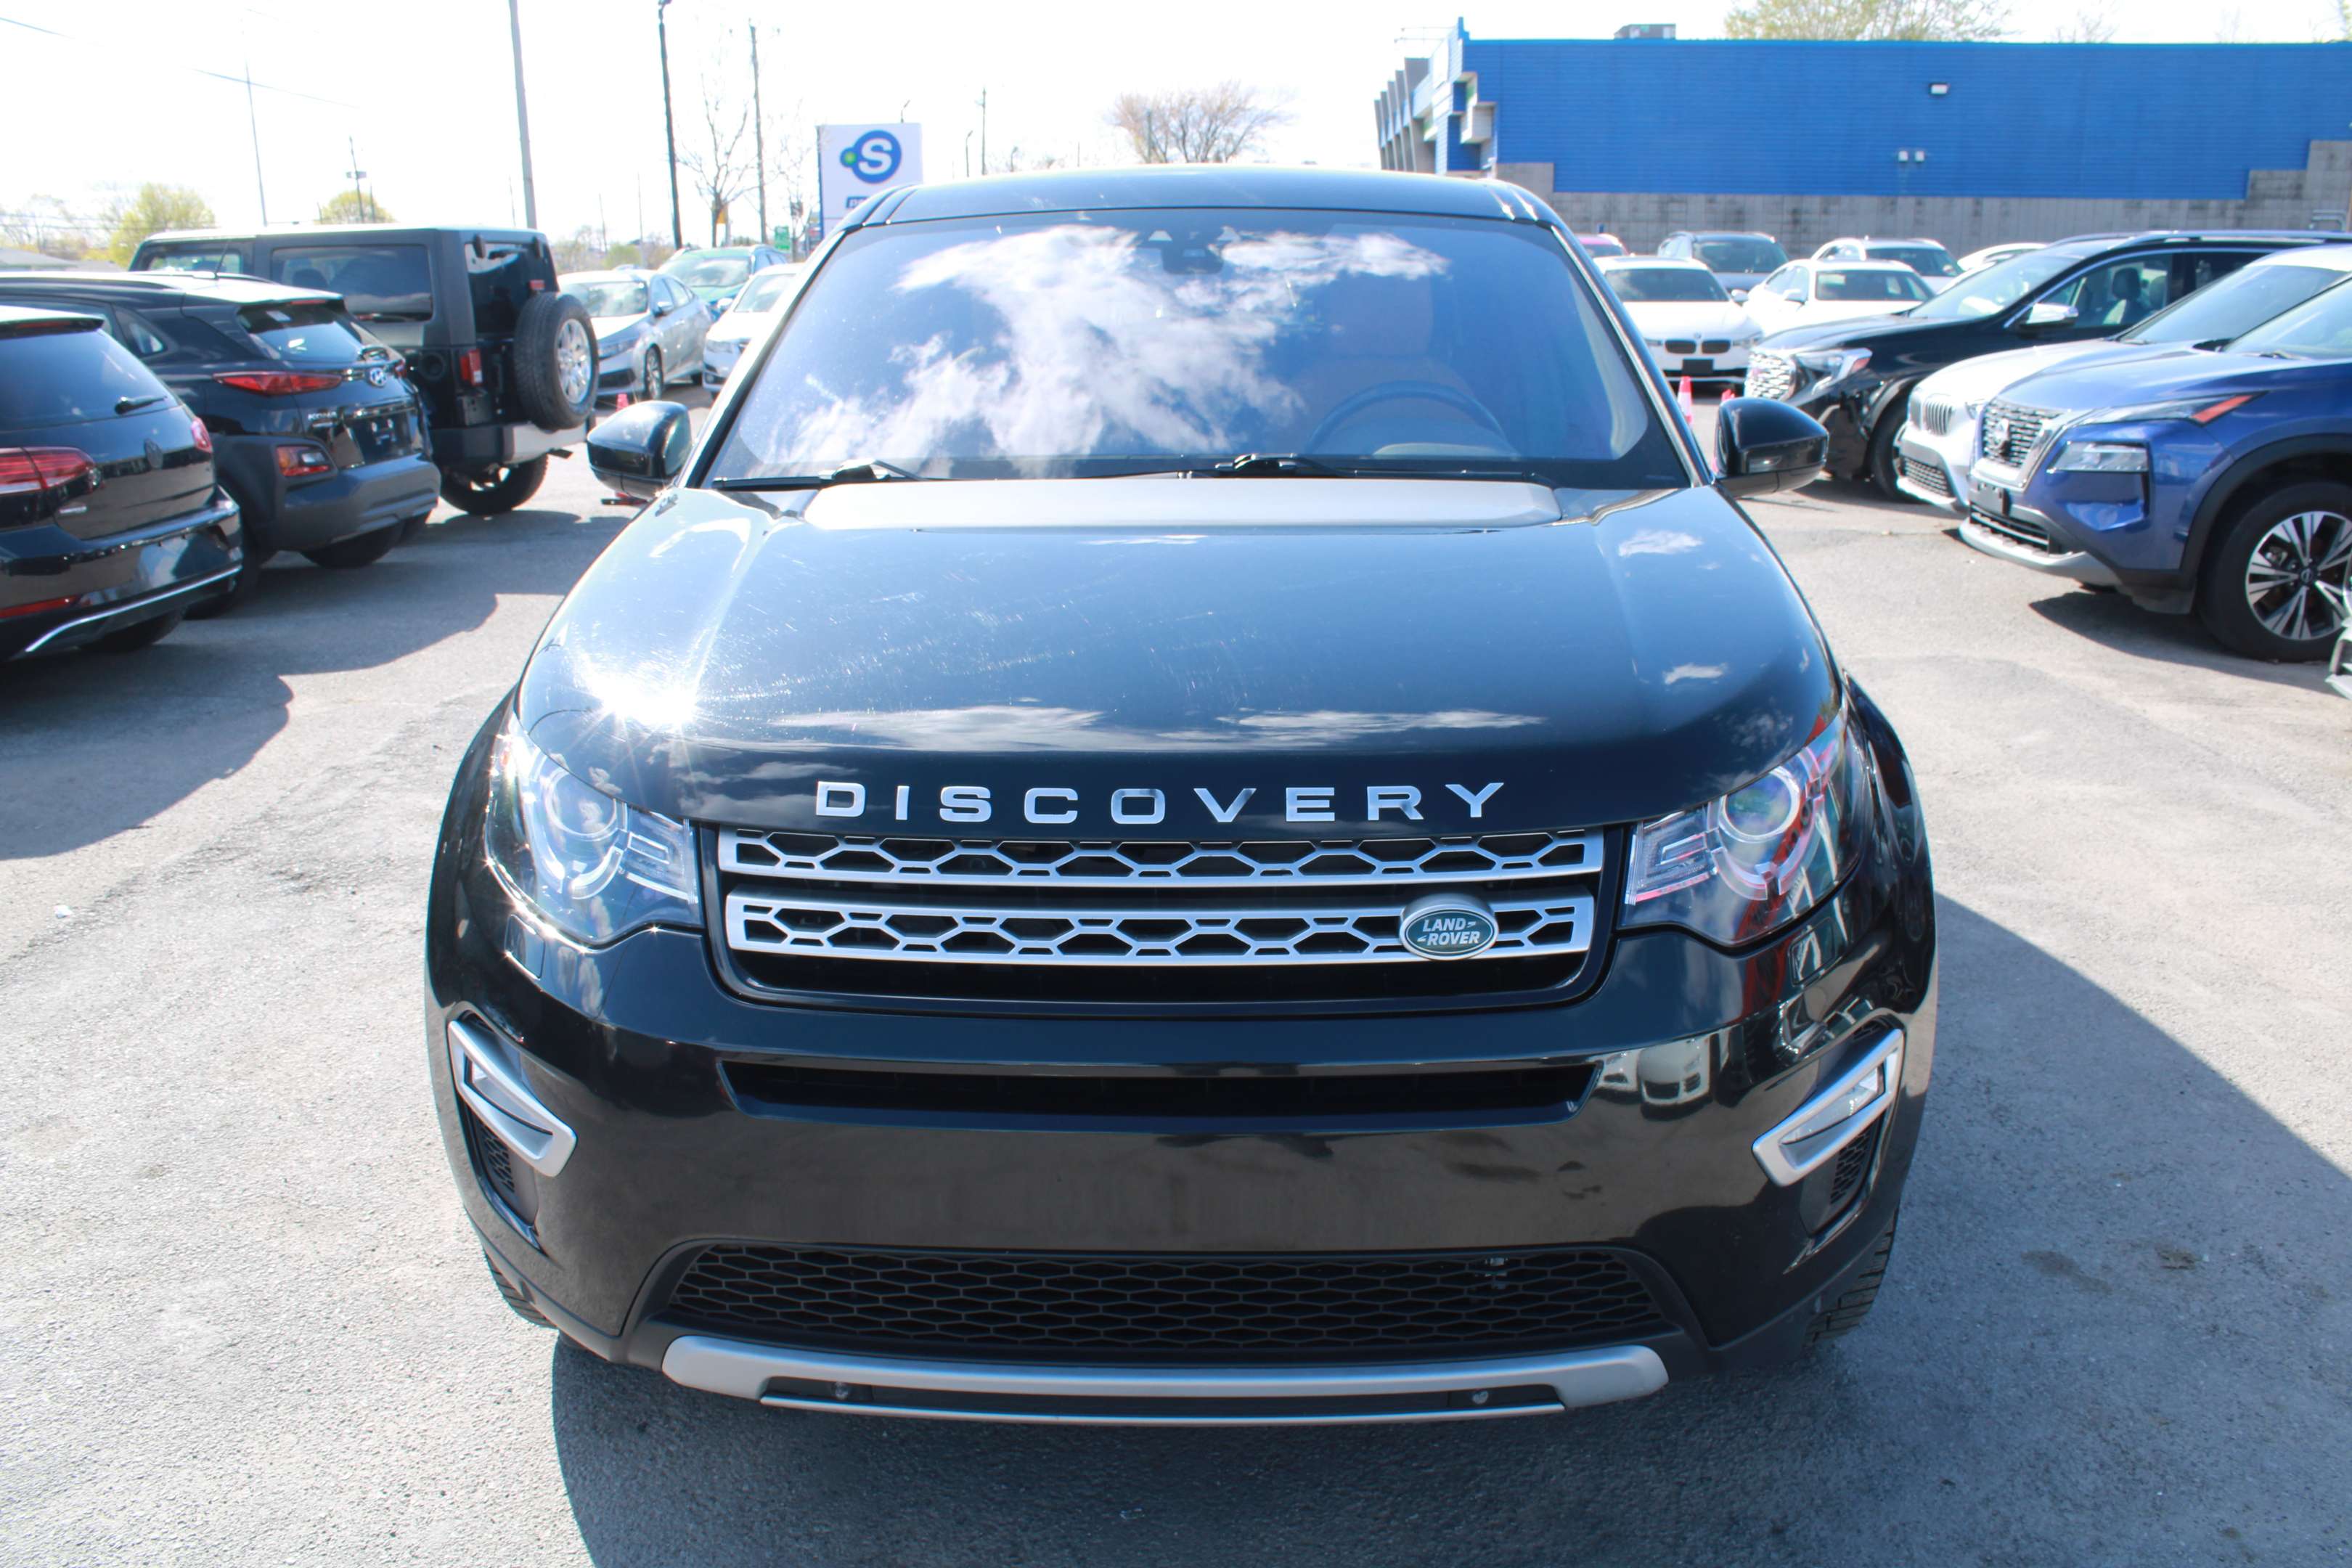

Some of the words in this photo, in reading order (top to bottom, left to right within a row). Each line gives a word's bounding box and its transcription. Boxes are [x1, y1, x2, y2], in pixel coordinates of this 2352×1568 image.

[857, 137, 892, 176] S
[815, 780, 1504, 825] DISCOVERY
[1422, 918, 1466, 932] LAND
[1426, 931, 1481, 946] ROVER
